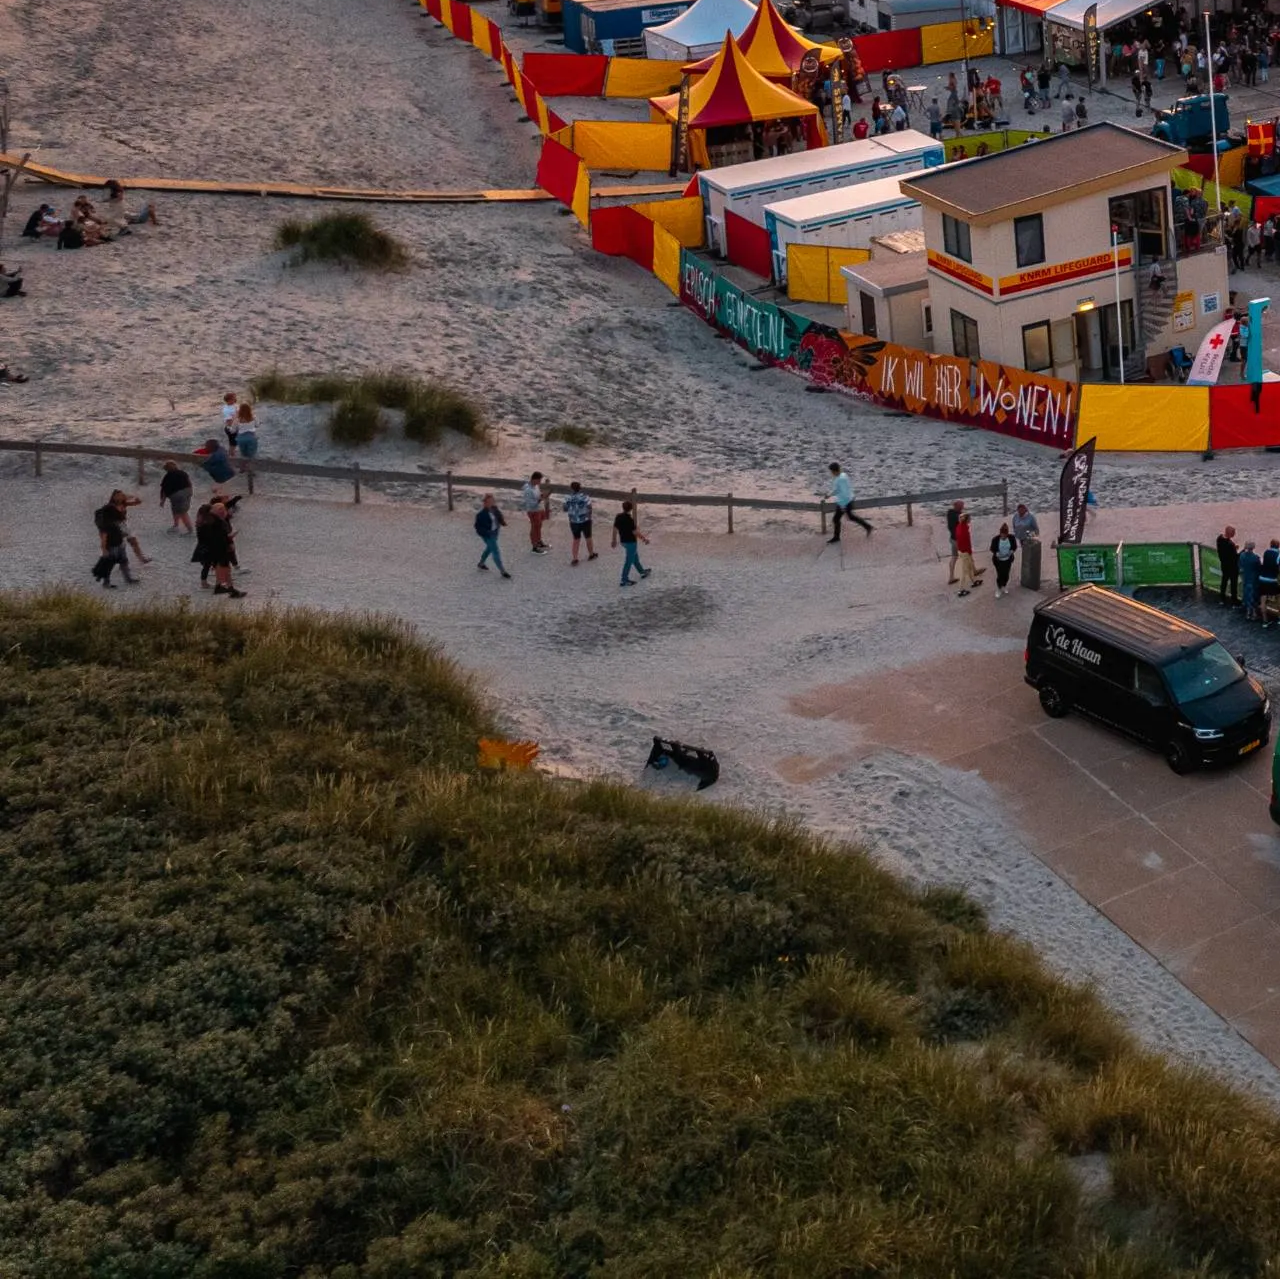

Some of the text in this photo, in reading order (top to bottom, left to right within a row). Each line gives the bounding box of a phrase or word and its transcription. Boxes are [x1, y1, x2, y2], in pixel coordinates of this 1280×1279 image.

[685, 263, 716, 314] EPISCH
[1019, 253, 1112, 283] KNRM LIFEGUARD
[881, 356, 899, 393] IK
[904, 359, 927, 401] WIL
[935, 364, 962, 409] HIER
[1056, 634, 1070, 650] de
[1072, 638, 1102, 666] Haan
